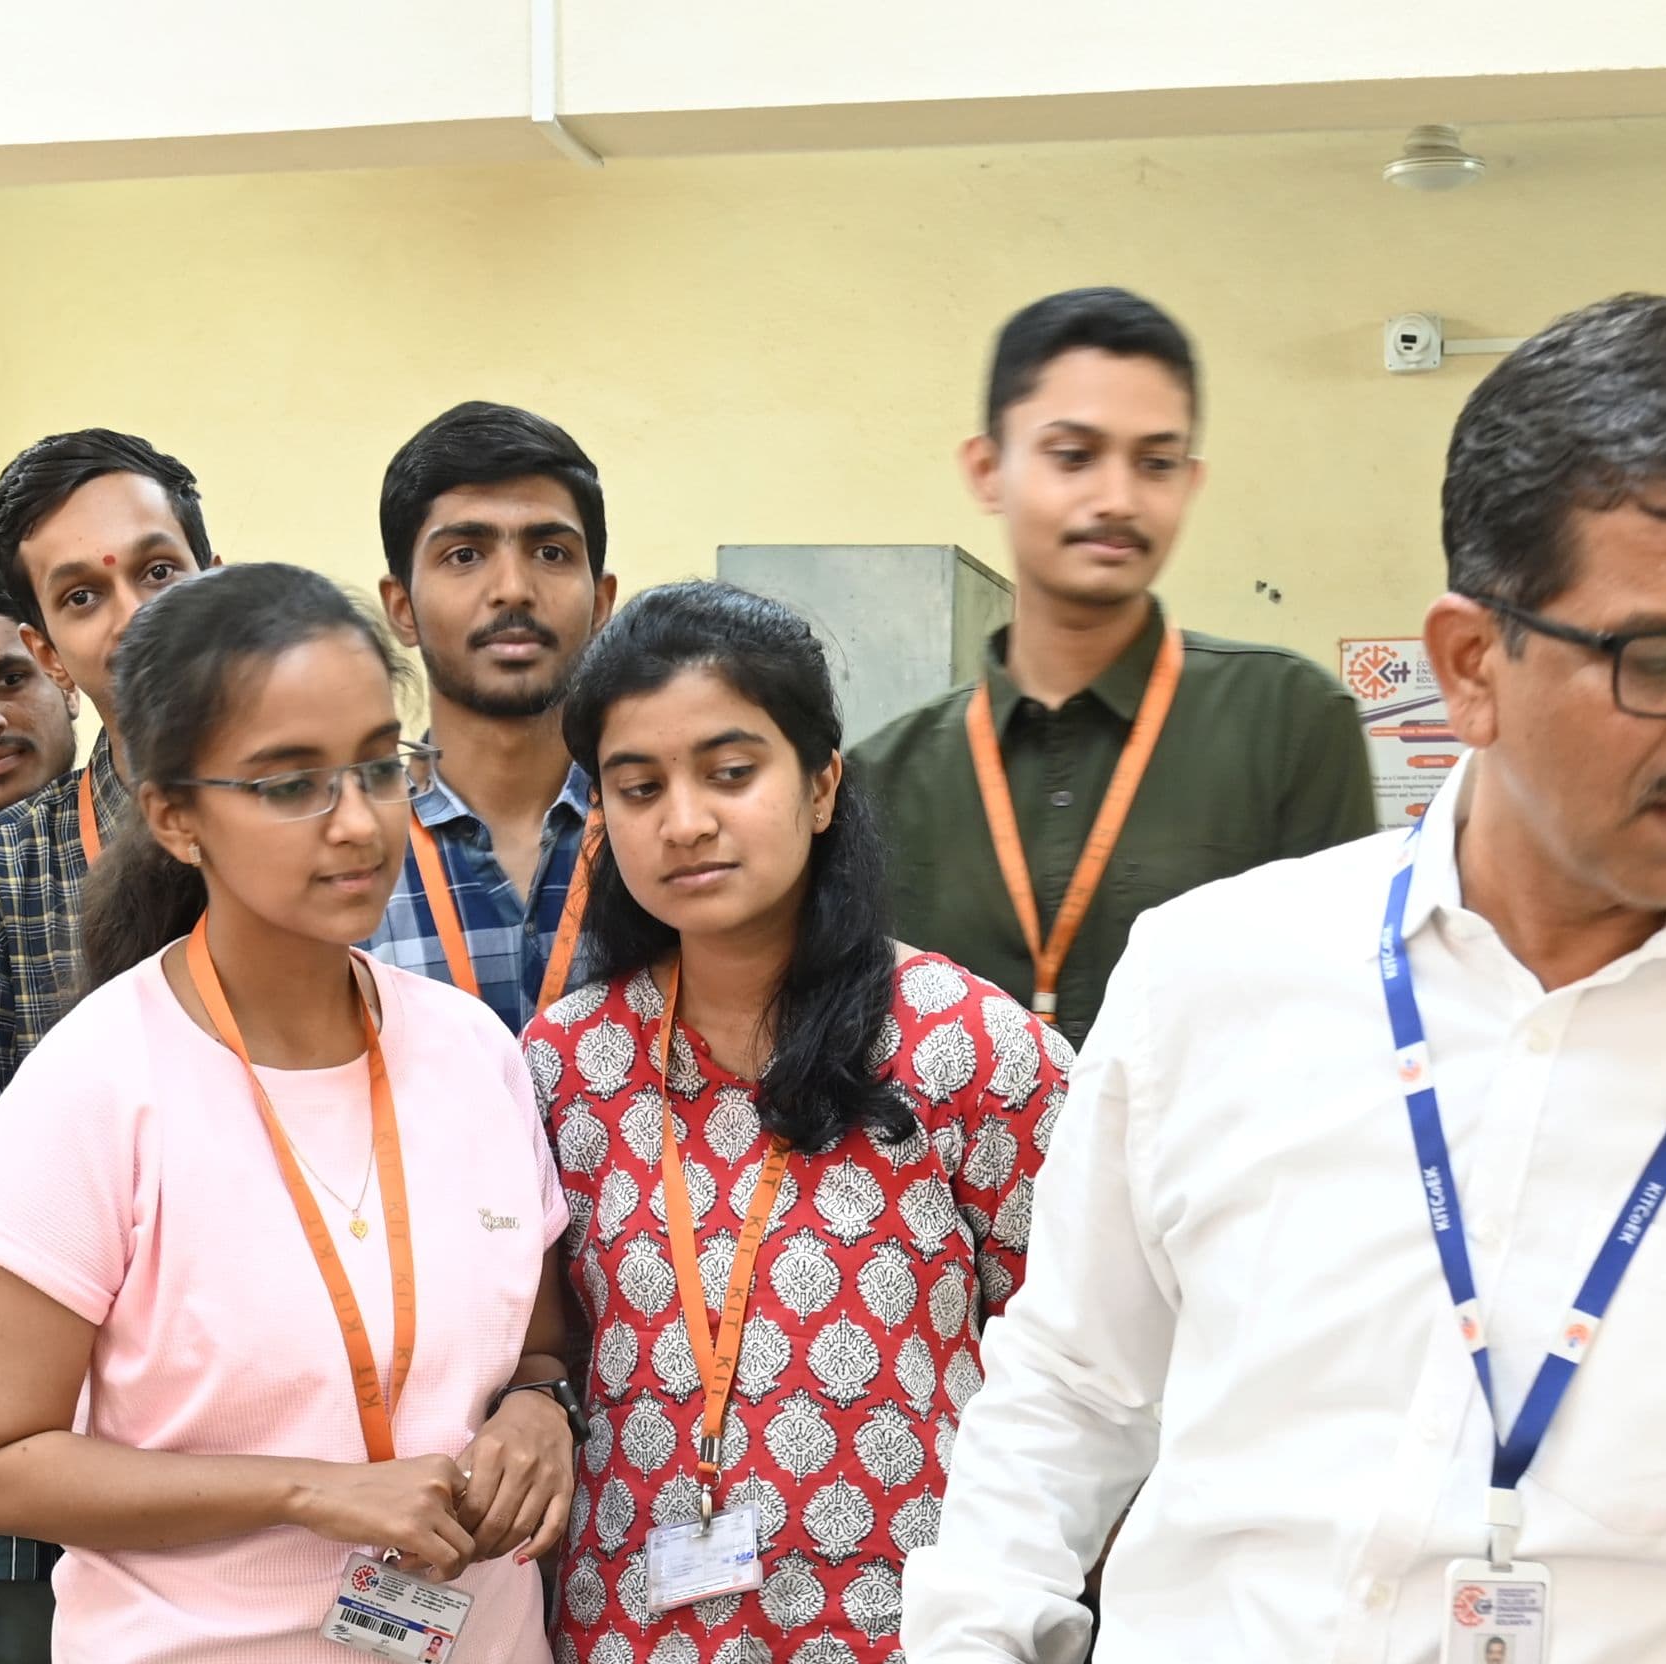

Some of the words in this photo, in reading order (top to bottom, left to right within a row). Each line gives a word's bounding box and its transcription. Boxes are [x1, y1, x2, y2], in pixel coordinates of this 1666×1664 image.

[739, 1216, 763, 1258] KIT
[396, 1272, 413, 1315] KIT
[725, 1287, 744, 1331] KIT
[355, 1365, 382, 1409] KIT
[710, 1356, 732, 1400] KIT
